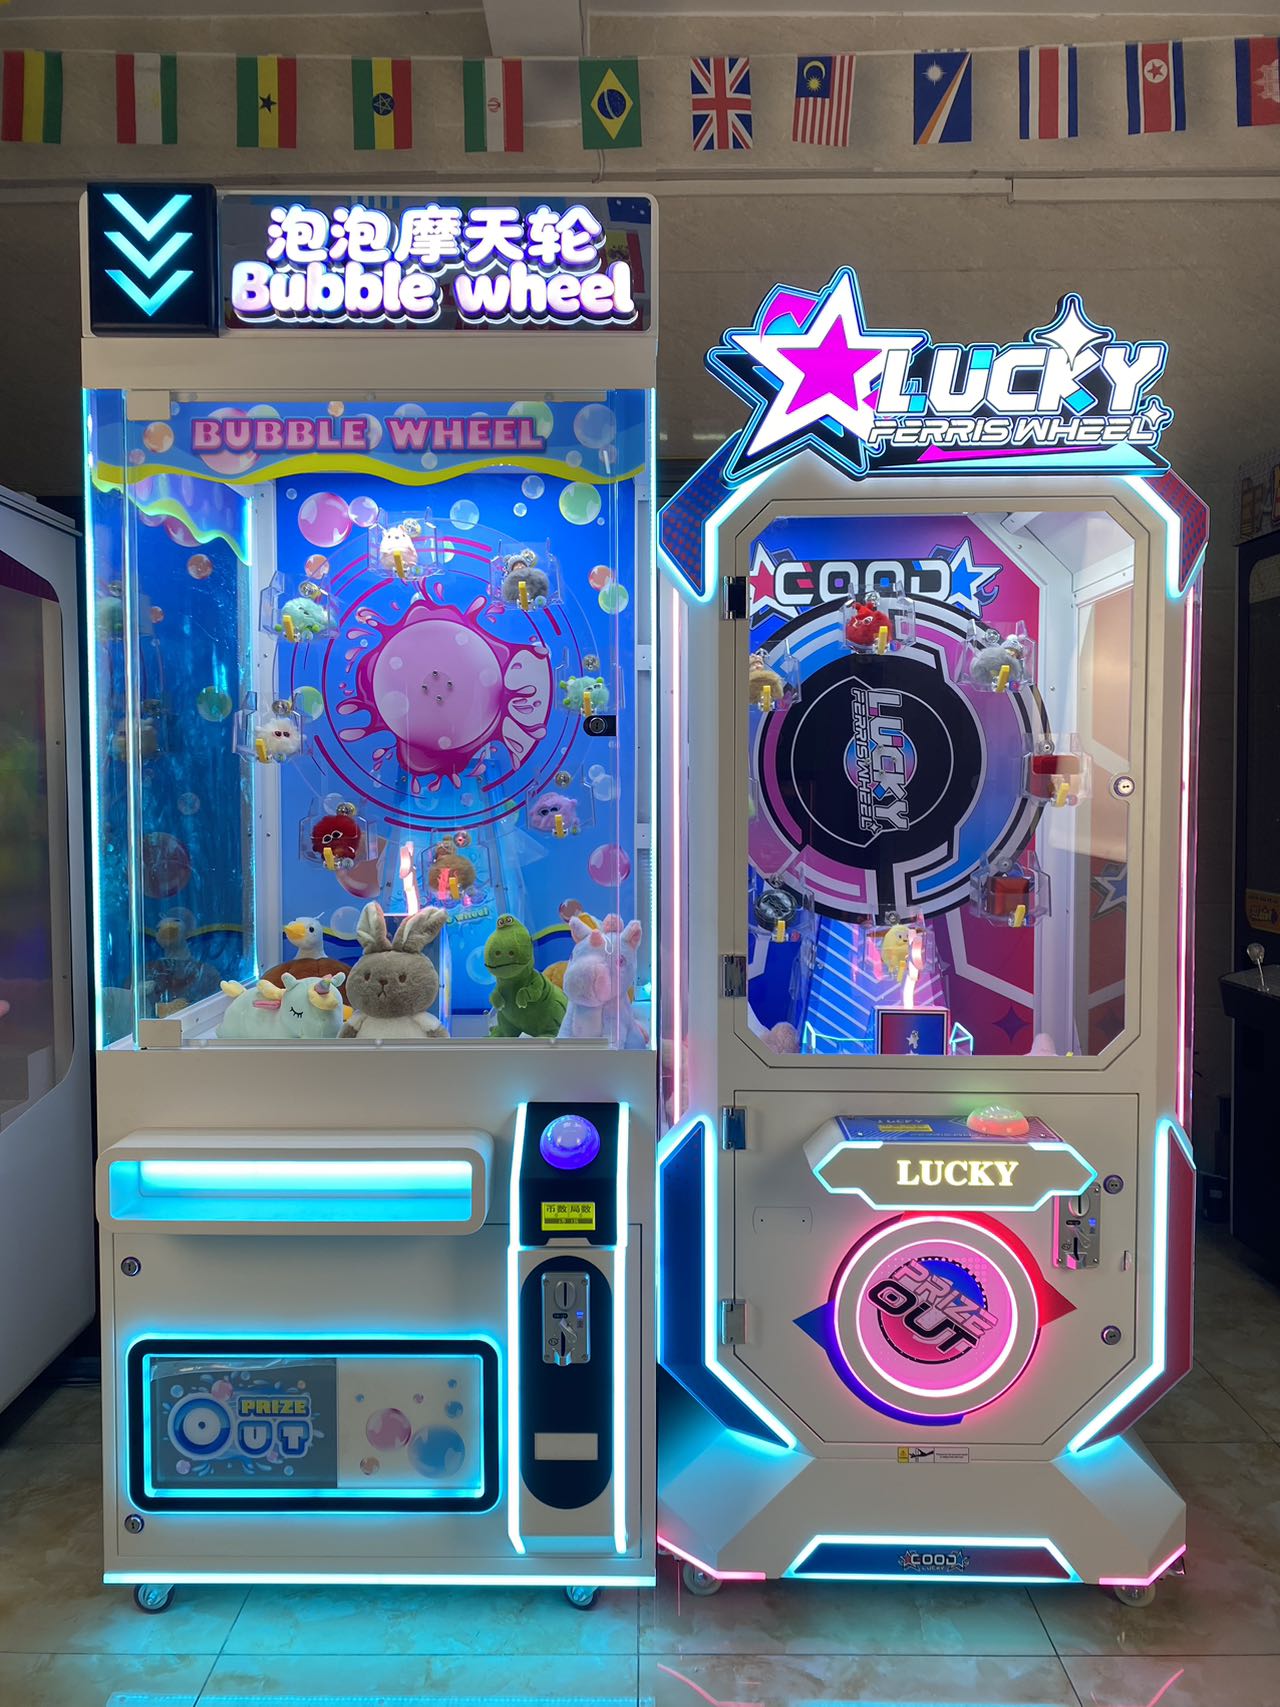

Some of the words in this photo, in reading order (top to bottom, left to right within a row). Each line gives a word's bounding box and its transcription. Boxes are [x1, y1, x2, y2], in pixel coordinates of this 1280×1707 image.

[266, 203, 602, 264] 泡泡摩天轮
[232, 261, 439, 315] Bubble
[453, 261, 635, 318] wheel
[875, 345, 1166, 414] LUCKY
[192, 417, 370, 452] BUBBLE
[388, 417, 546, 452] WHEEL
[867, 417, 1012, 444] FERRIS
[1013, 417, 1157, 444] WHEEL
[867, 690, 910, 831] LUCKY
[856, 759, 874, 831] WHEEL
[896, 1160, 1019, 1186] LUCKY
[867, 1279, 980, 1354] OUT
[894, 1260, 998, 1338] PRIZE
[241, 1397, 309, 1415] PRIZE
